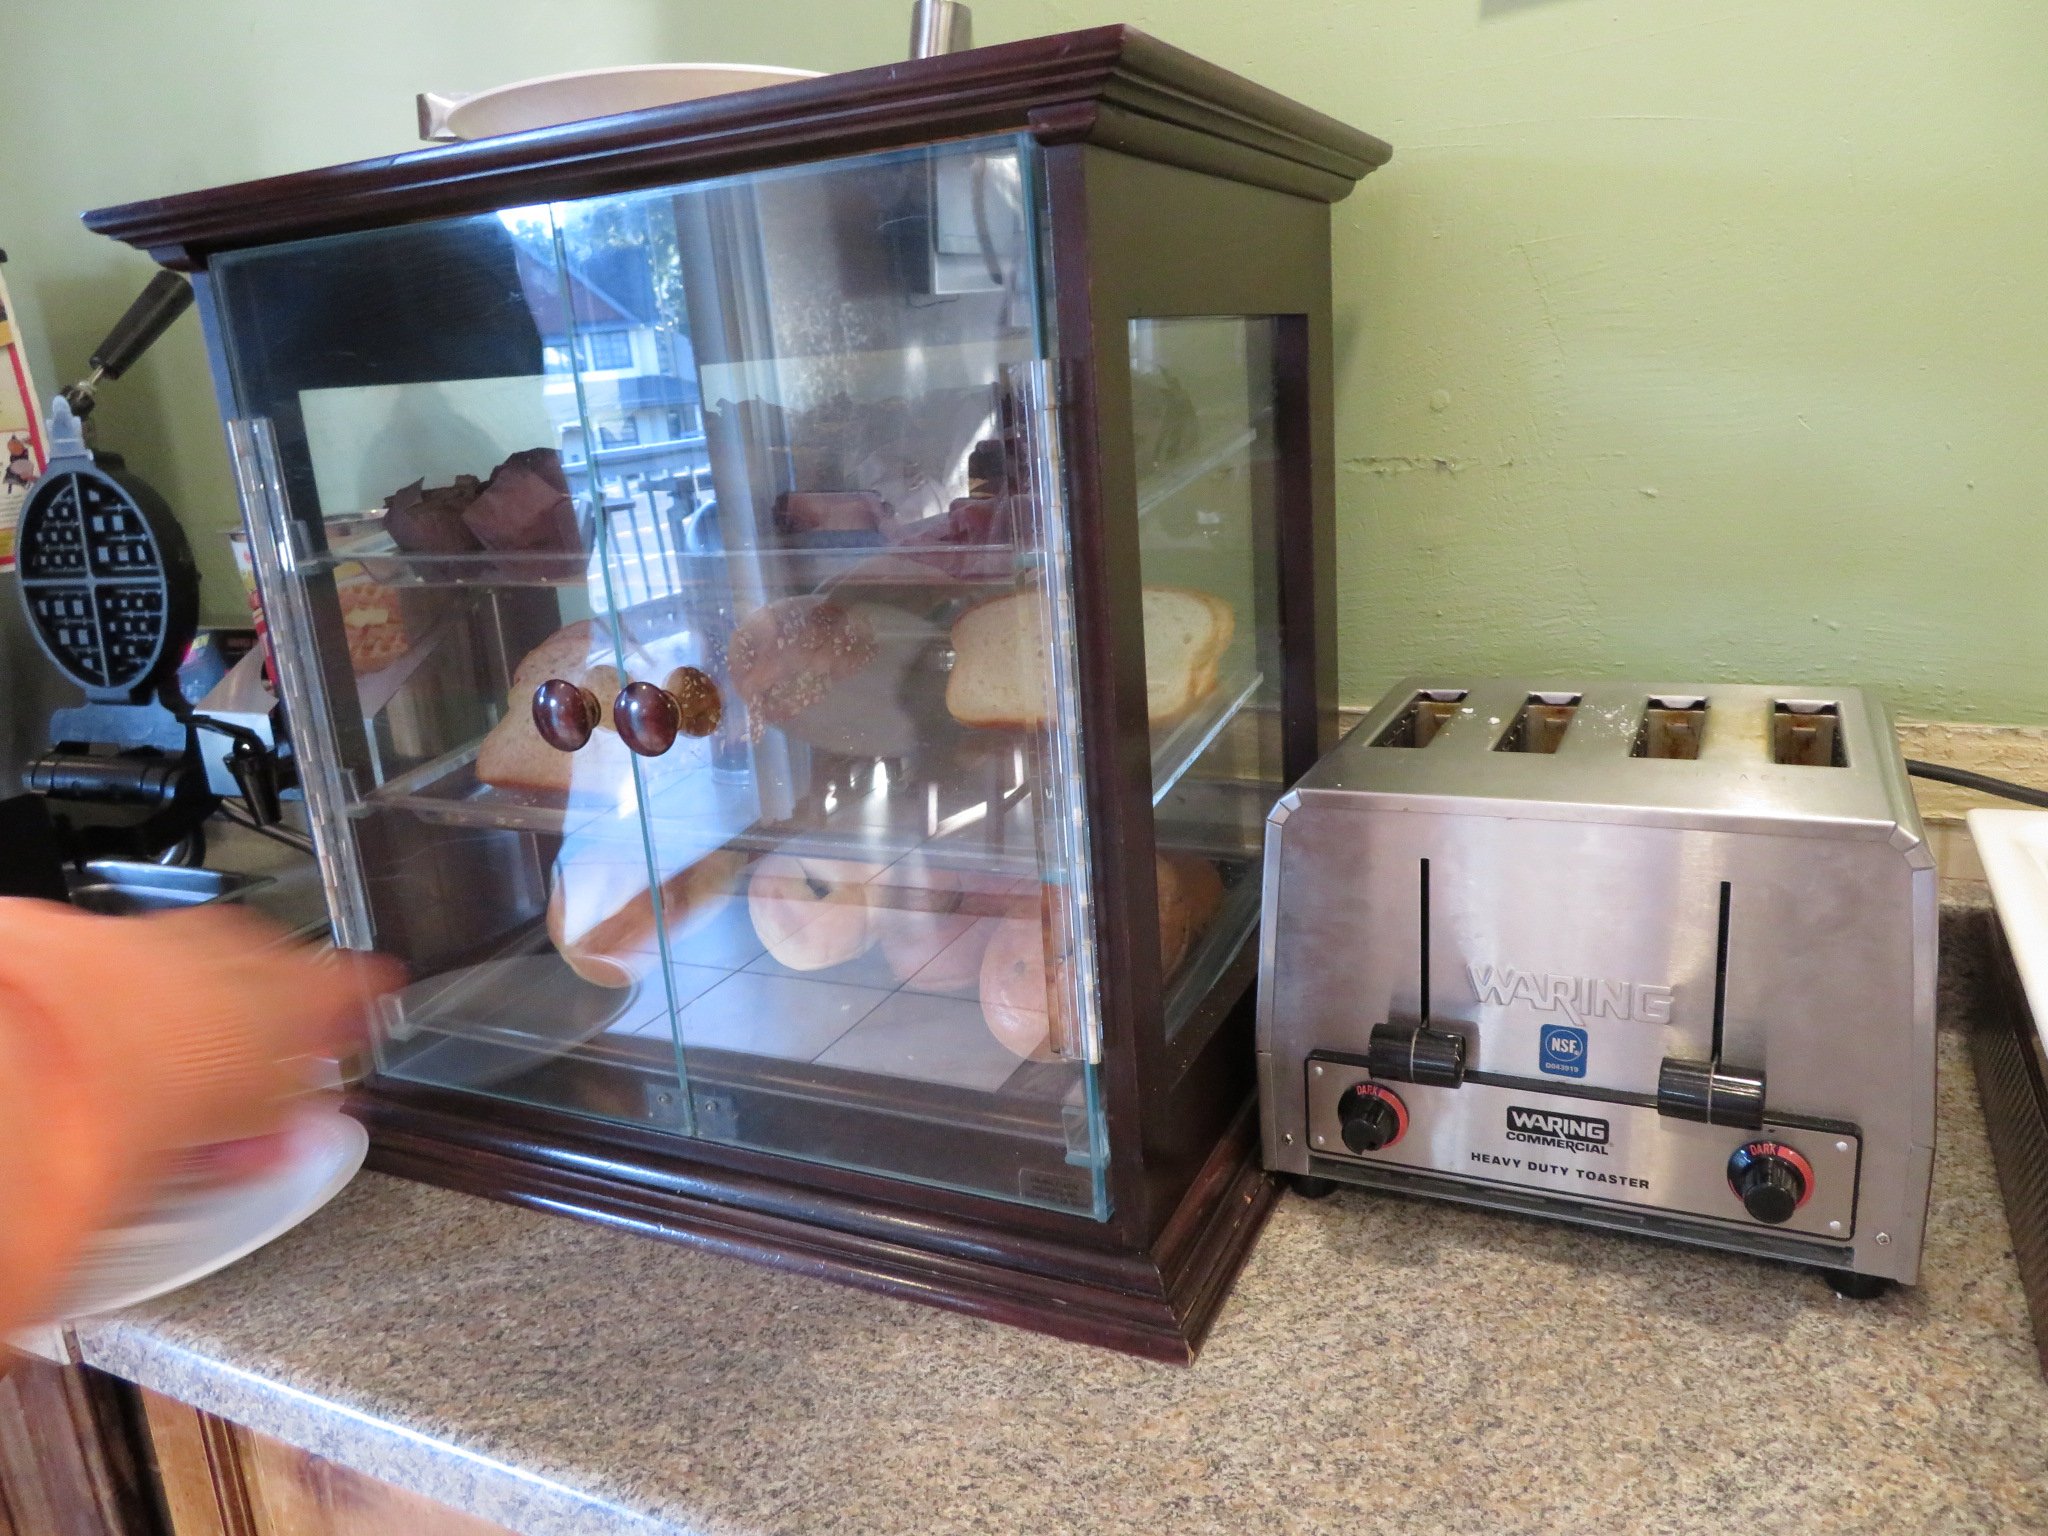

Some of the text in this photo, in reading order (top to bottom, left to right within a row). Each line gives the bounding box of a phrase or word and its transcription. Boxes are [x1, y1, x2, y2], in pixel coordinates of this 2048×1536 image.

[1467, 963, 1675, 1026] WARING
[1551, 1037, 1577, 1053] NSF
[1356, 1085, 1378, 1096] DARK
[1511, 1110, 1605, 1140] WARING
[1506, 1131, 1609, 1155] COMMERCIAL
[1749, 1143, 1777, 1156] DARK
[1471, 1152, 1650, 1189] HEAVY DUTY TOASTER
